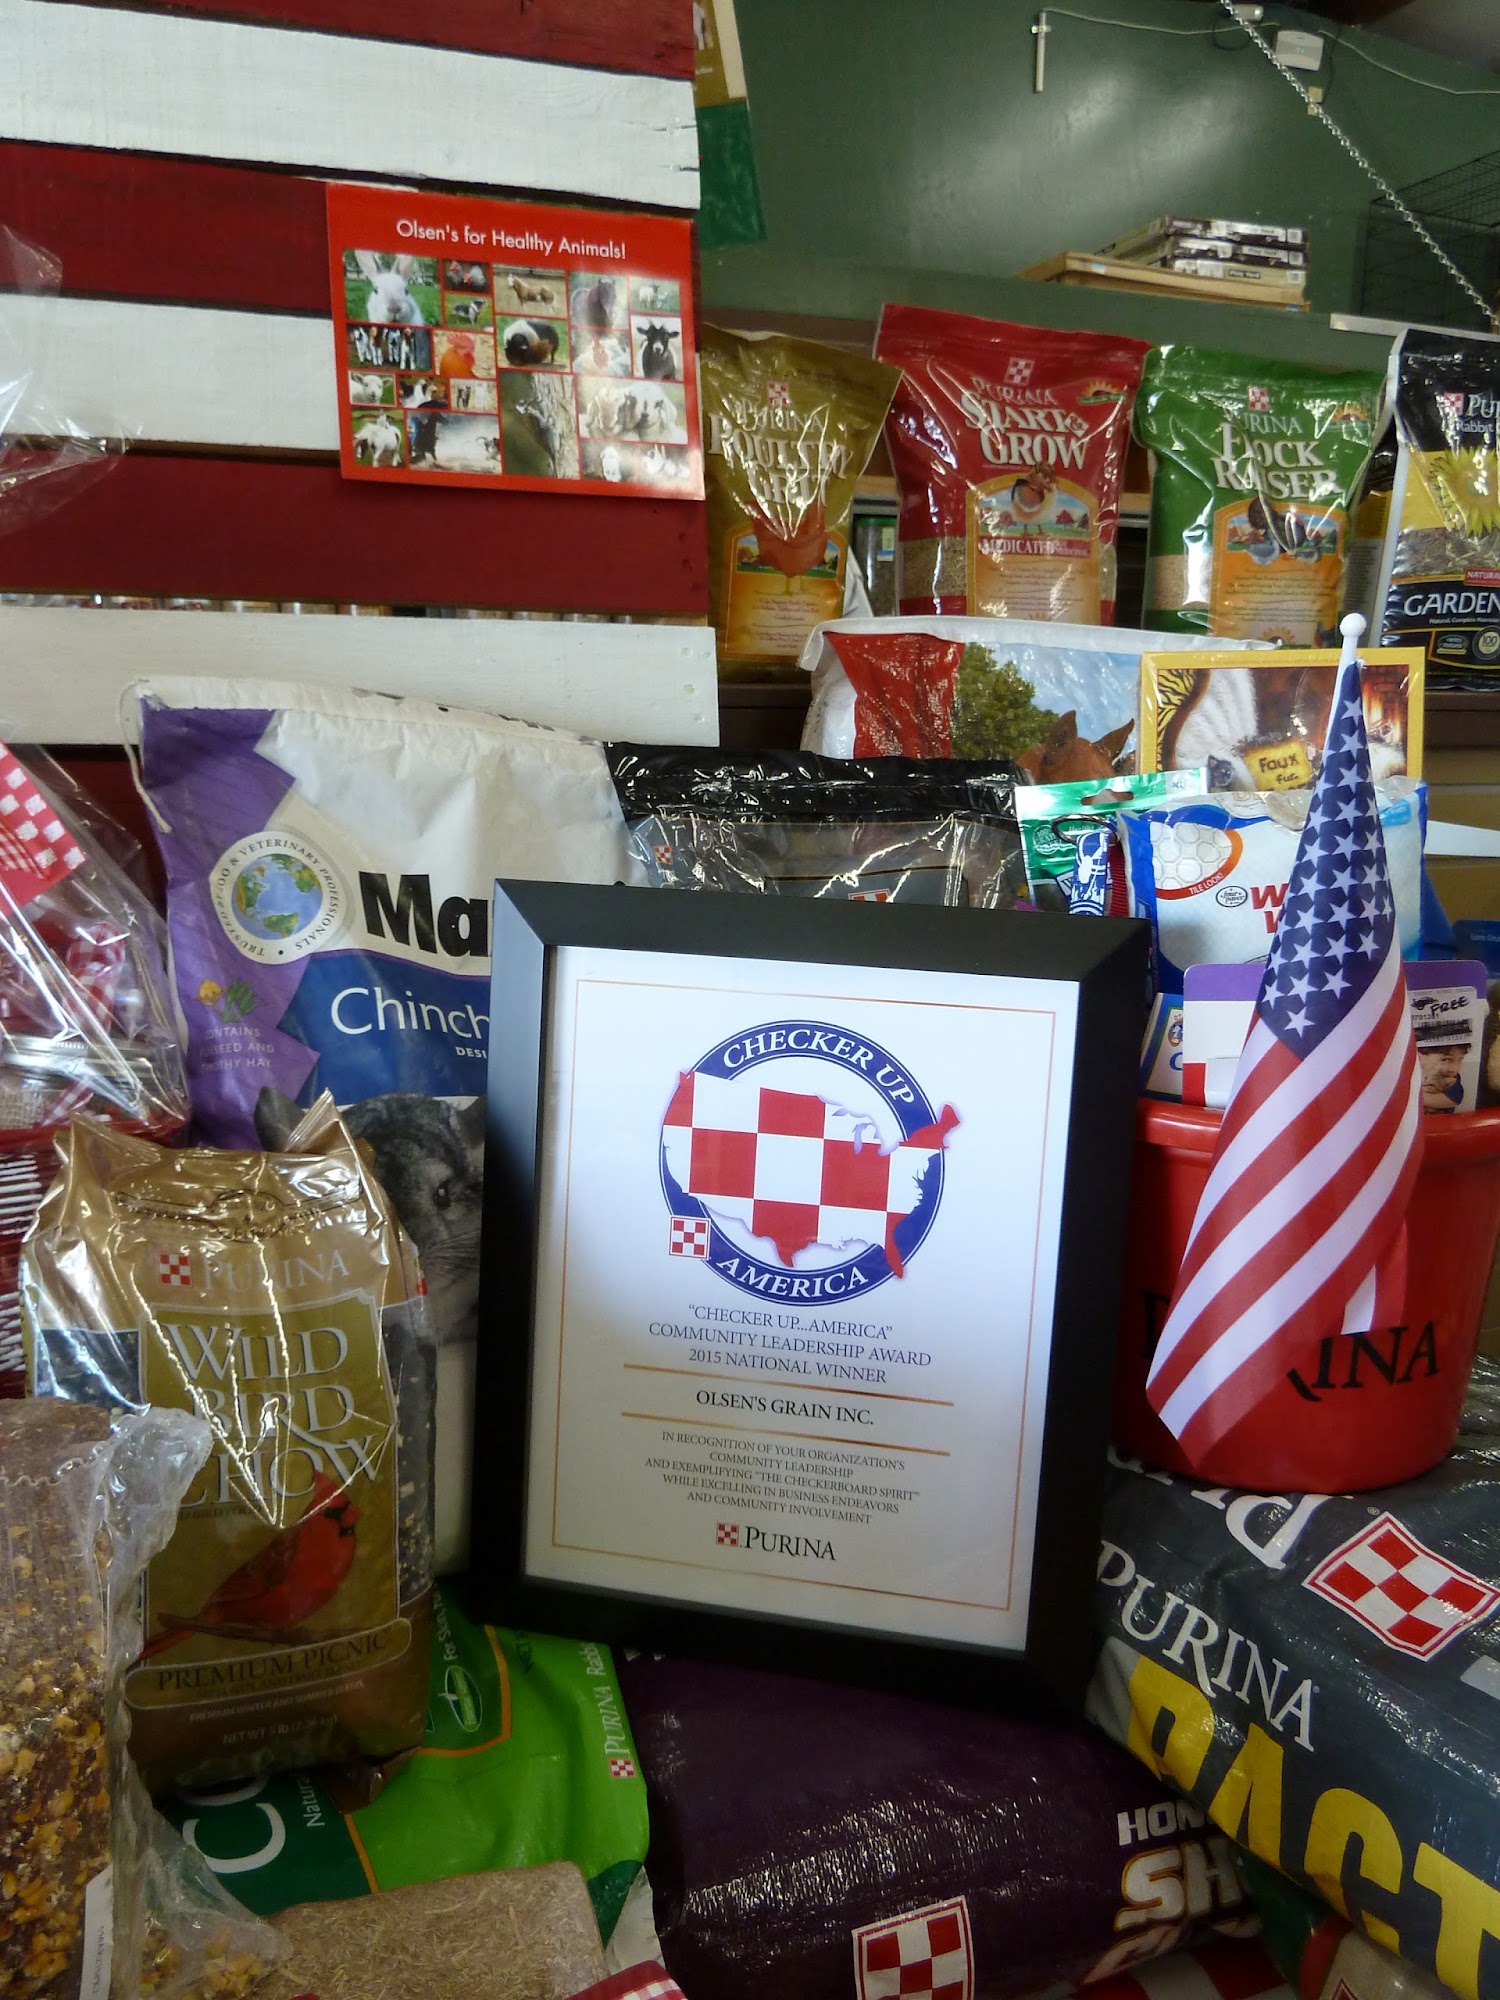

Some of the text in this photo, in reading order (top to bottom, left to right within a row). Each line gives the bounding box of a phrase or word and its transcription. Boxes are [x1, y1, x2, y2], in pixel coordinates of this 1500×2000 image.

[396, 219, 626, 259] Olsen's for Healthy Animals!
[961, 390, 1070, 434] START
[1243, 412, 1303, 435] RINA
[708, 413, 853, 479] POULTRY
[980, 431, 1089, 470] GROW
[1220, 422, 1324, 468] FLOCK
[1210, 457, 1344, 499] RAISER
[980, 538, 1056, 556] MEDICATED
[1467, 571, 1500, 580] NATURA
[1404, 592, 1500, 616] GARDEN
[1259, 753, 1299, 772] Faux
[239, 838, 320, 865] VETERINARY
[295, 868, 339, 950] PROFESSIONALS
[1188, 883, 1204, 896] TILE
[1430, 996, 1470, 1017] FREE
[206, 1026, 261, 1040] ONTAINS
[248, 1043, 275, 1053] AND
[246, 1057, 272, 1068] HAY
[723, 1029, 915, 1104] CHECKER UP
[204, 1249, 350, 1292] PURINA
[716, 1253, 869, 1298] AMERICA
[163, 1322, 349, 1382] WILD
[649, 1322, 932, 1367] COMMUNITY LEADERSHIP AWARD
[689, 1348, 887, 1383] 2015 NATIONAL WINNER
[191, 1384, 356, 1440] BIRD
[696, 1389, 874, 1425] OLSEN'S GRAIN INC.
[662, 1431, 906, 1471] IN RECOGNITION OF YOUR ORGANIZATION'S
[709, 1451, 854, 1478] COMMUNITY LEADERSHIP
[645, 1457, 670, 1470] AND
[672, 1460, 753, 1480] EXEMPLIFYING
[784, 1473, 878, 1496] CHECKERBOARD
[663, 1474, 900, 1514] WHILE EXCELLING IN BUSINESS ENDEAVORS
[687, 1491, 872, 1525] AND COMMUNITY INVOLVEMENT
[744, 1525, 837, 1561] PURINA
[158, 1654, 293, 1690] PREMIUM
[303, 1633, 388, 1668] PICNIC
[442, 1641, 458, 1661] For
[1097, 1540, 1314, 1752] PURINA
[580, 1641, 631, 1755] PURINA Rabb
